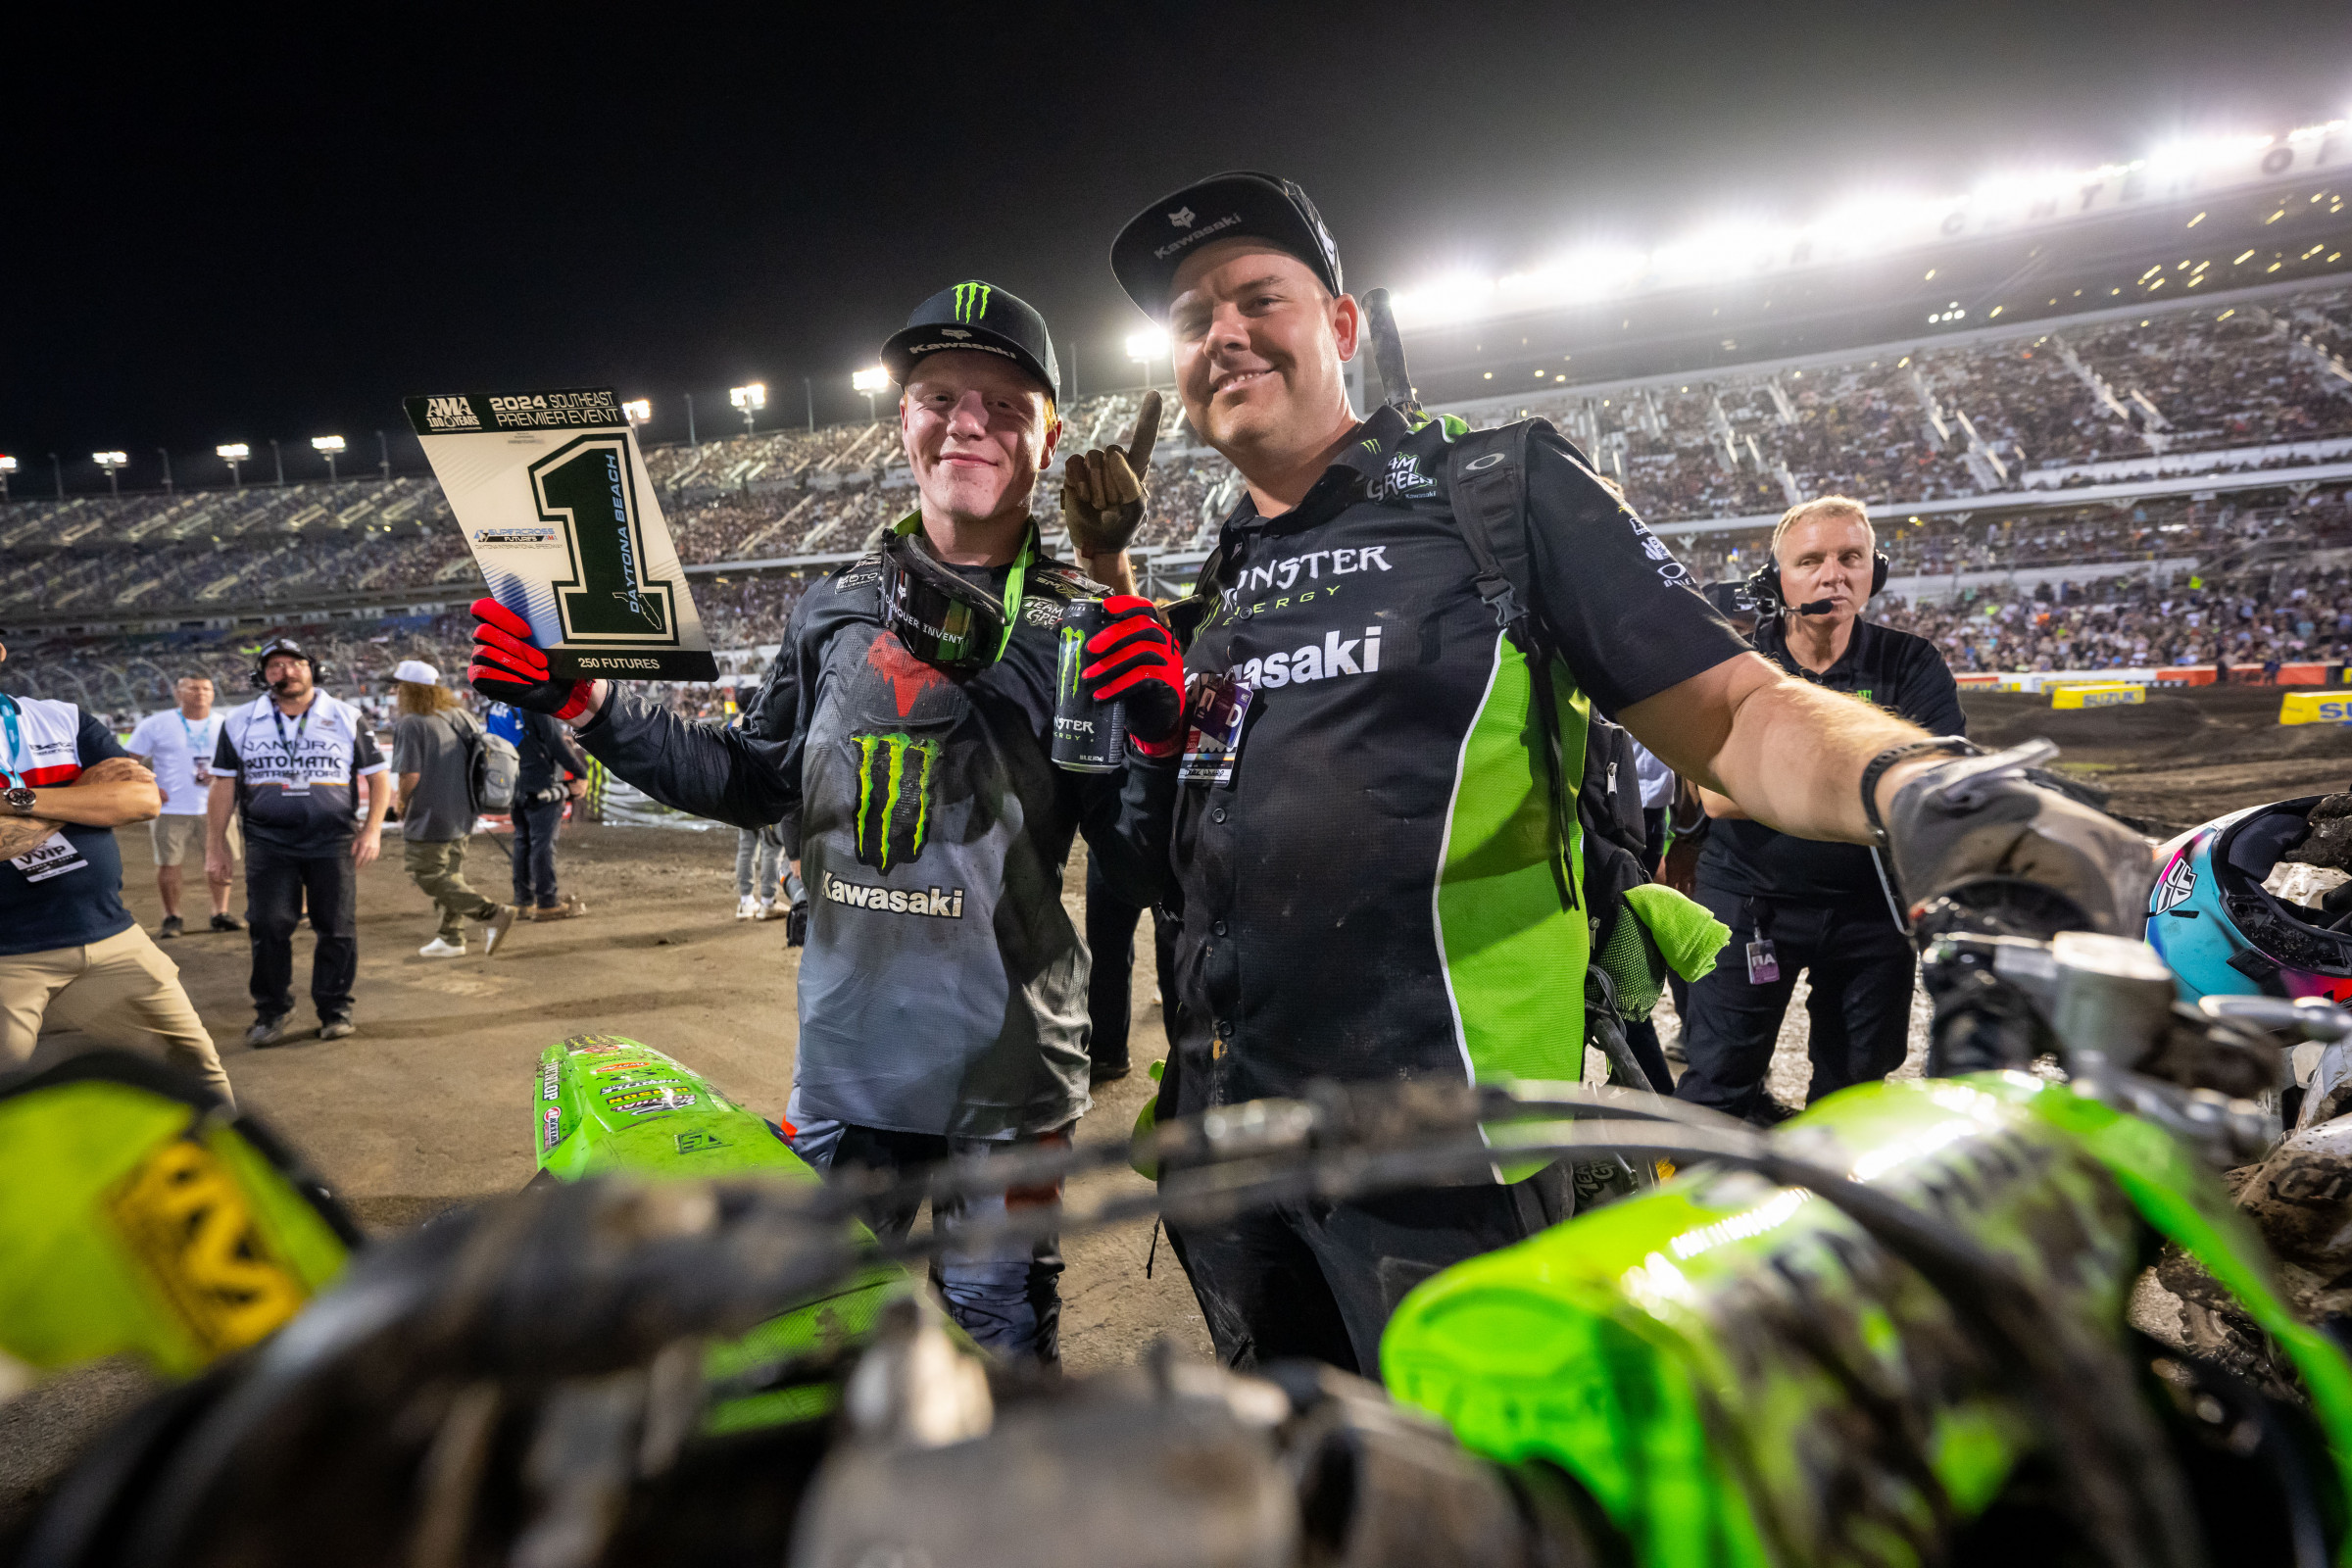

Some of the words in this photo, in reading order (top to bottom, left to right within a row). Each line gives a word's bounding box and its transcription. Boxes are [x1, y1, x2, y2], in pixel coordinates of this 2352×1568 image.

[1153, 213, 1243, 260] Kawasaki
[908, 342, 1017, 360] Kawasaki
[426, 397, 475, 417] AMA
[489, 395, 548, 411] 2024
[549, 392, 614, 408] SOUTHEAST
[426, 416, 444, 428] 100
[453, 416, 481, 427] YEARS
[495, 412, 568, 427] PREMIER
[567, 408, 618, 423] EVENT
[605, 453, 627, 522] BEACH
[488, 527, 556, 536] SUPERCROSS
[527, 432, 680, 647] 1
[615, 525, 640, 613] DAYTONA
[885, 593, 920, 629] CONQUER
[923, 622, 963, 645] INVENT
[578, 658, 601, 668] 250
[601, 658, 661, 669] FUTURES
[822, 869, 963, 917] Kawasaki
